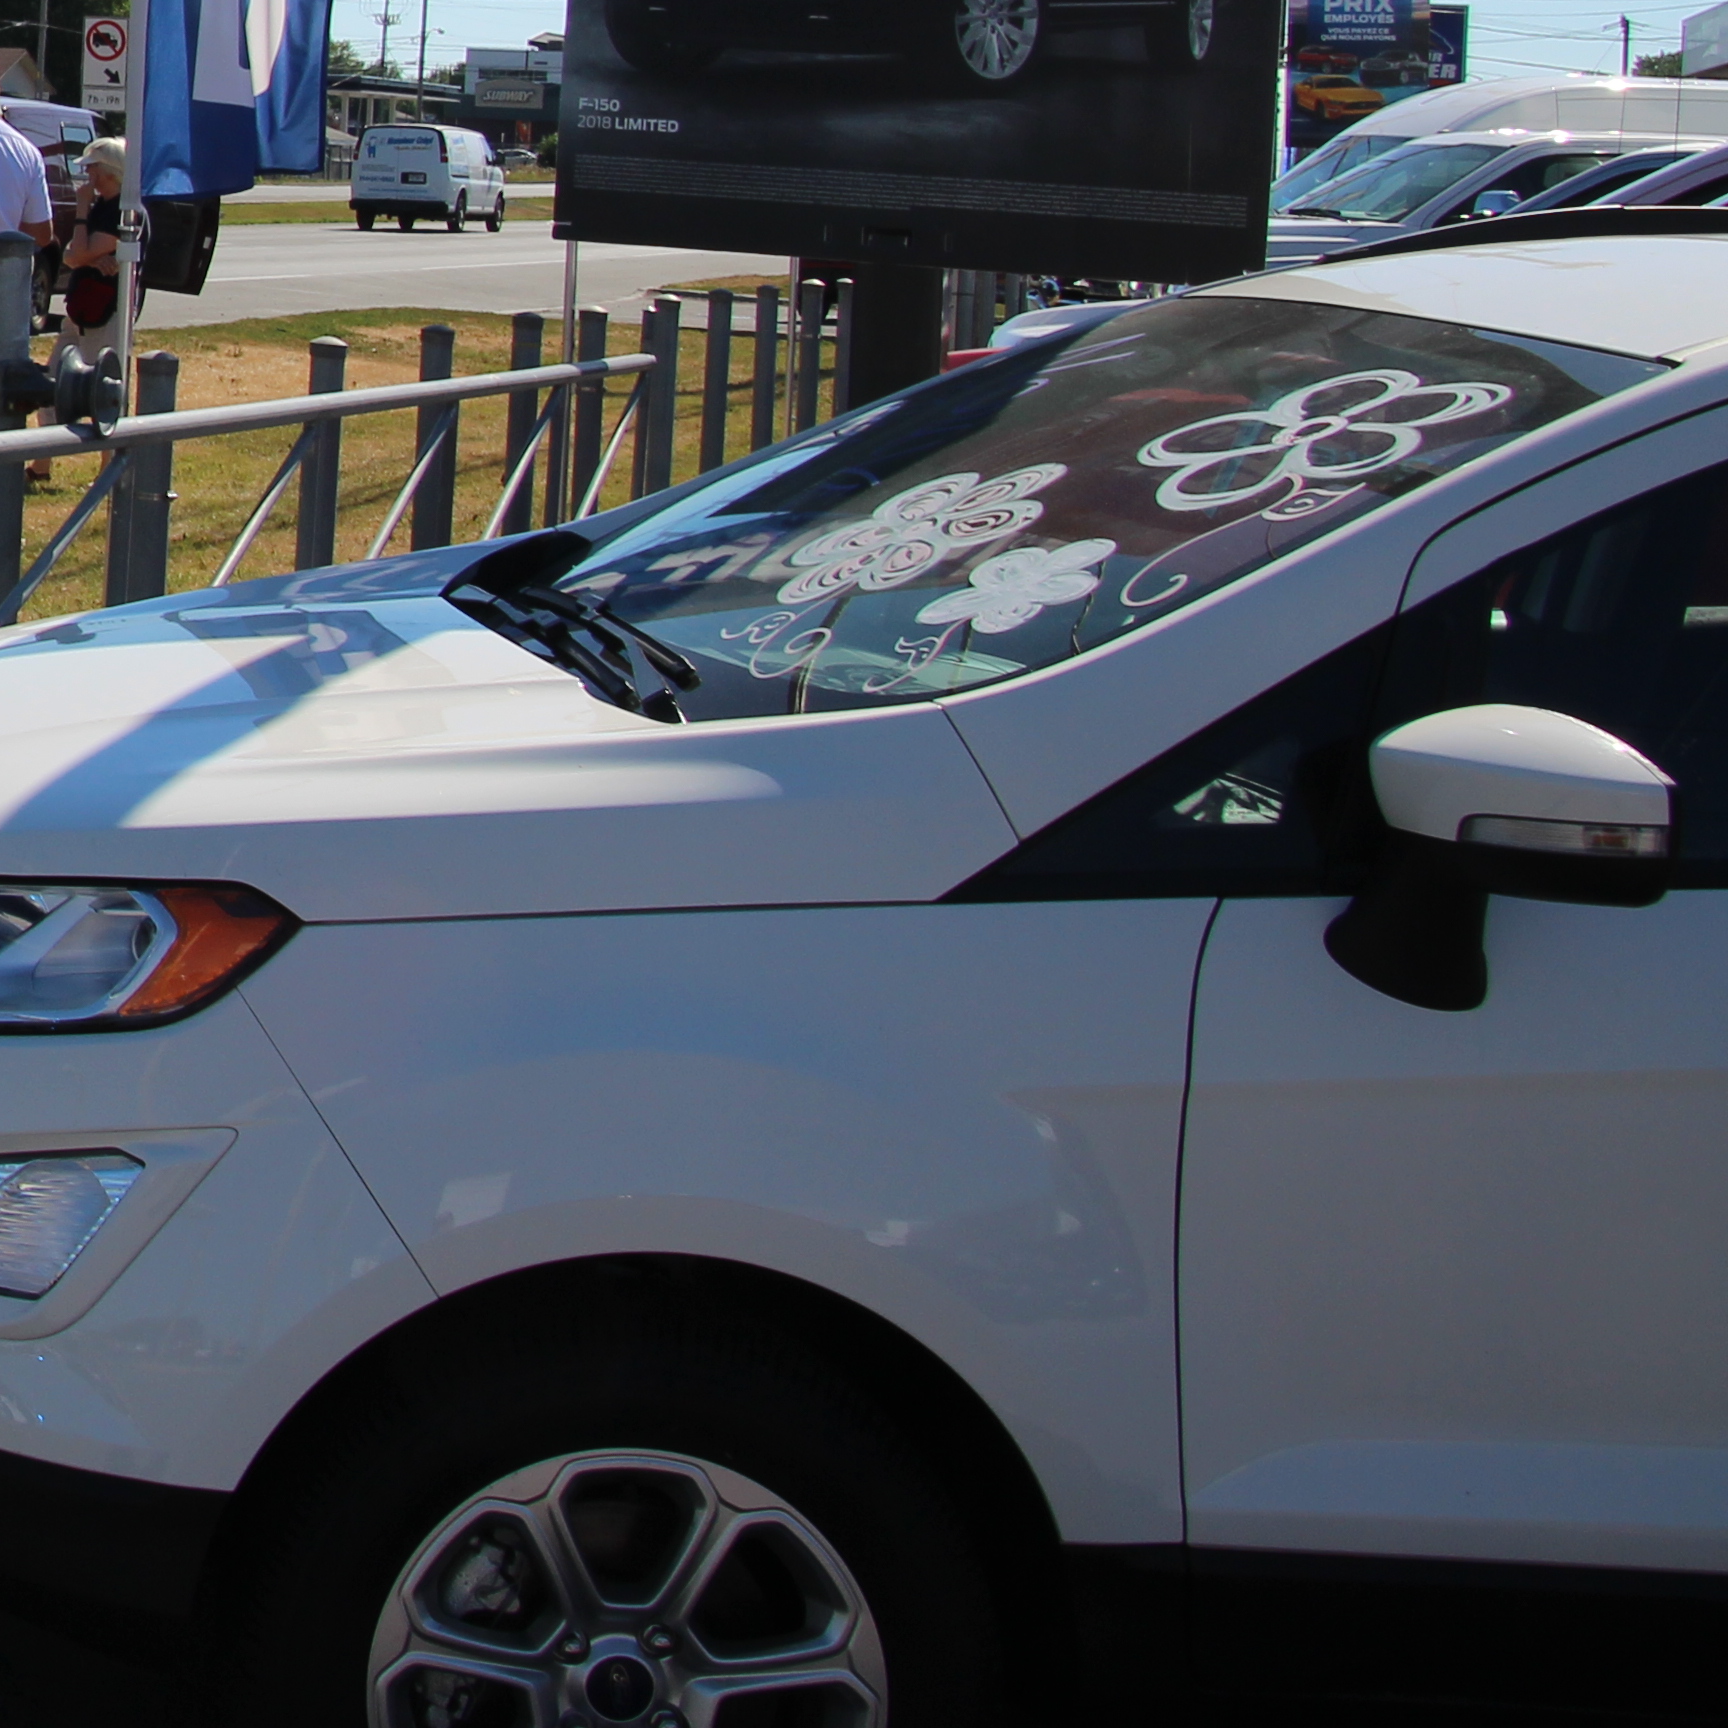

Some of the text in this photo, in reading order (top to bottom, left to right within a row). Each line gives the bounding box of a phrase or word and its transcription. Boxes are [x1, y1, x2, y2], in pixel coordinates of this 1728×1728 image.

[1324, 13, 1395, 24] EMPLOYÉS
[1328, 27, 1350, 35] VOUS
[1351, 27, 1377, 35] PAYEZ
[483, 90, 535, 103] SUBWAY
[578, 97, 621, 112] F-150
[577, 115, 680, 133] 2018 LIMITED
